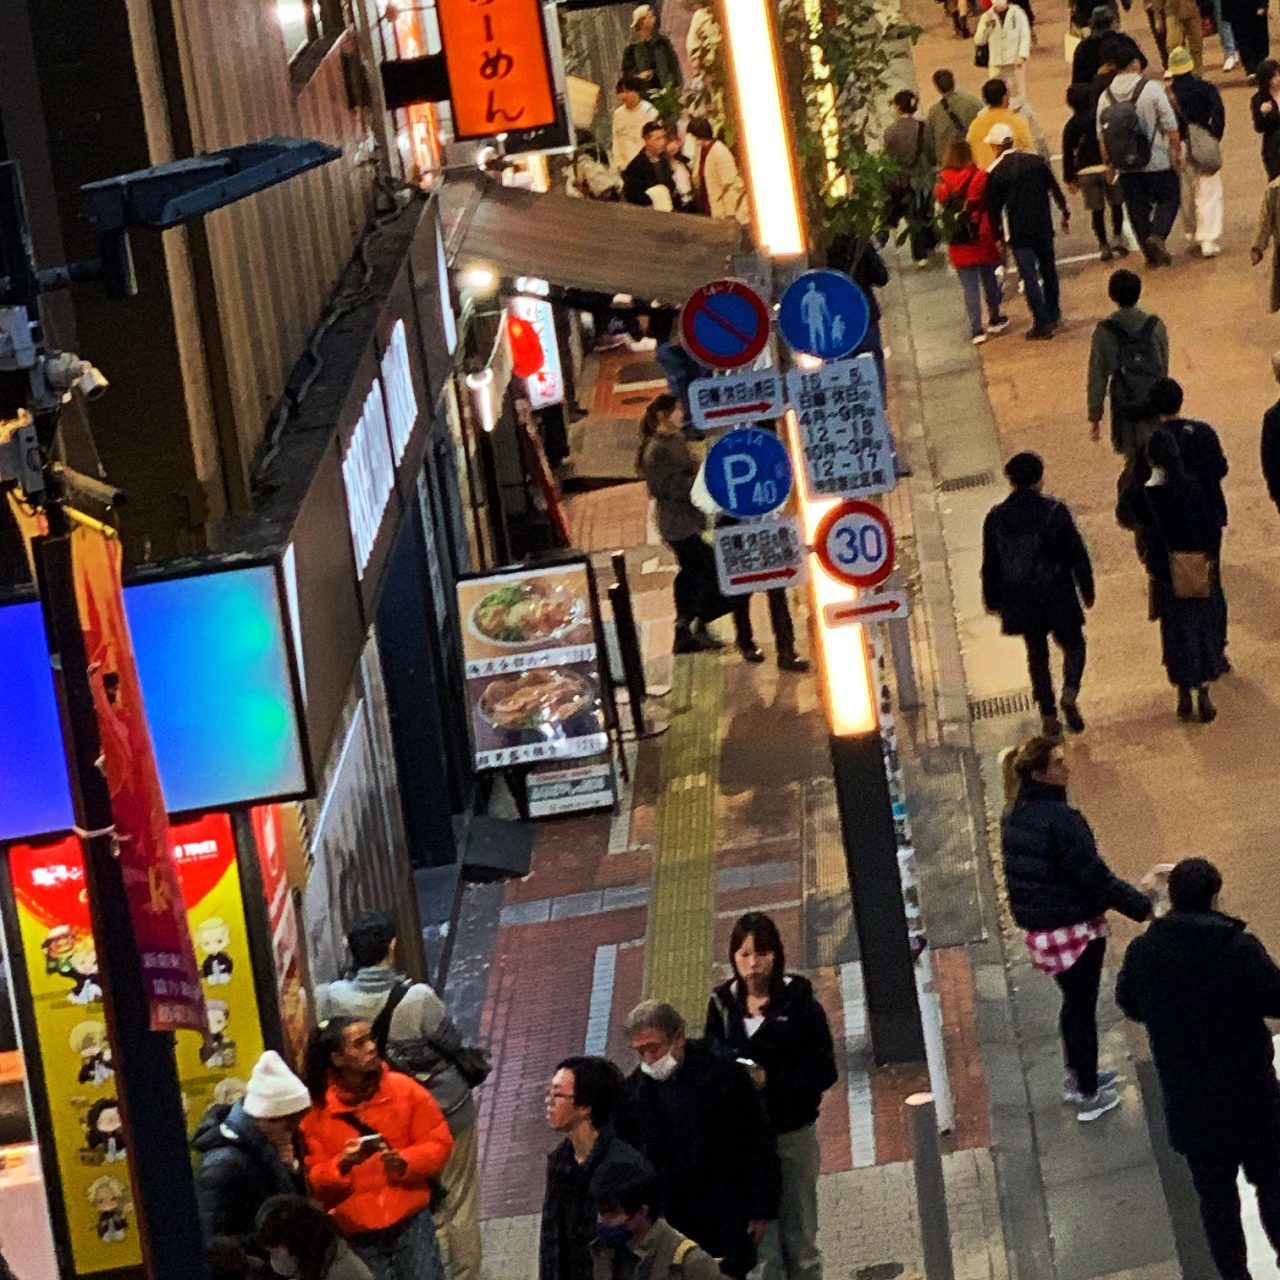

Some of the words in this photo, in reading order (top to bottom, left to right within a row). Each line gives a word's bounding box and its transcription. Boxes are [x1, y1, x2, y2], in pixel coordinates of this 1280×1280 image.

[724, 454, 757, 509] P
[753, 480, 777, 505] 40
[835, 524, 882, 564] 30
